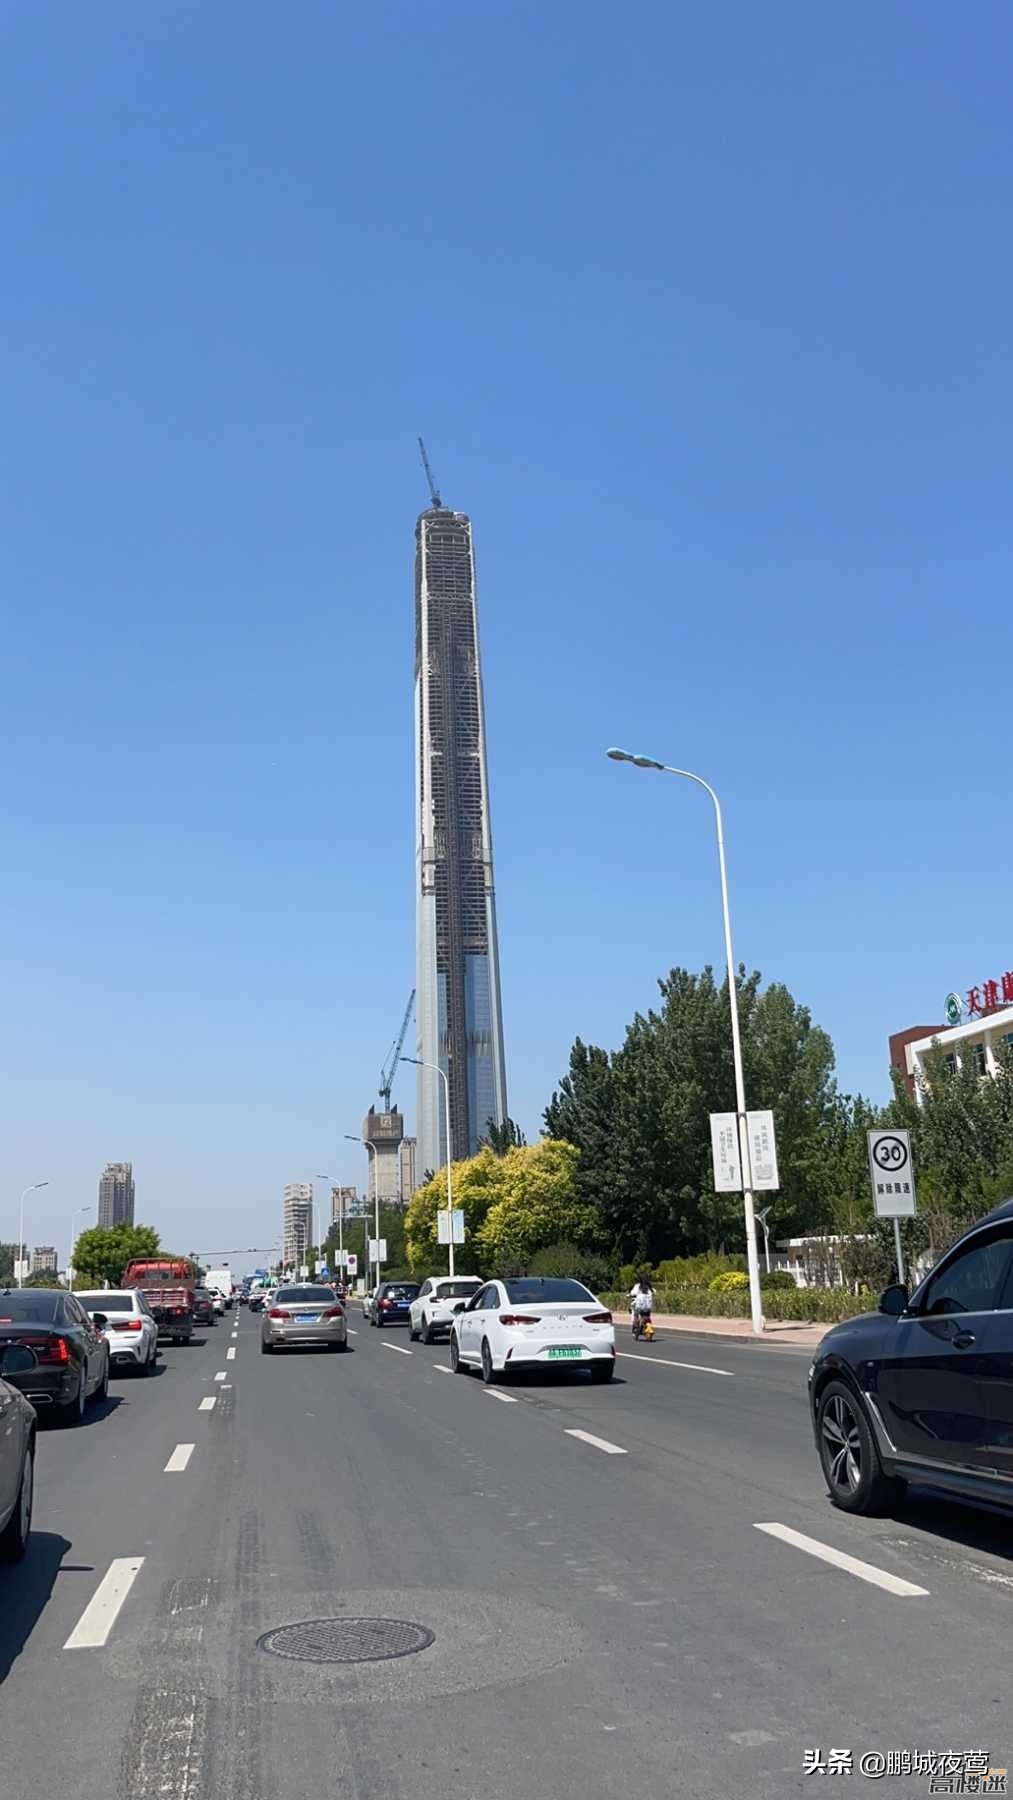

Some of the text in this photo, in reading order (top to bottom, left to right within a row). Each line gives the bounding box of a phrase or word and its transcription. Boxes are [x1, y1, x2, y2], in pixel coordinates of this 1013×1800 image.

[880, 1146, 901, 1161] 30
[877, 1182, 910, 1194] 解除限速
